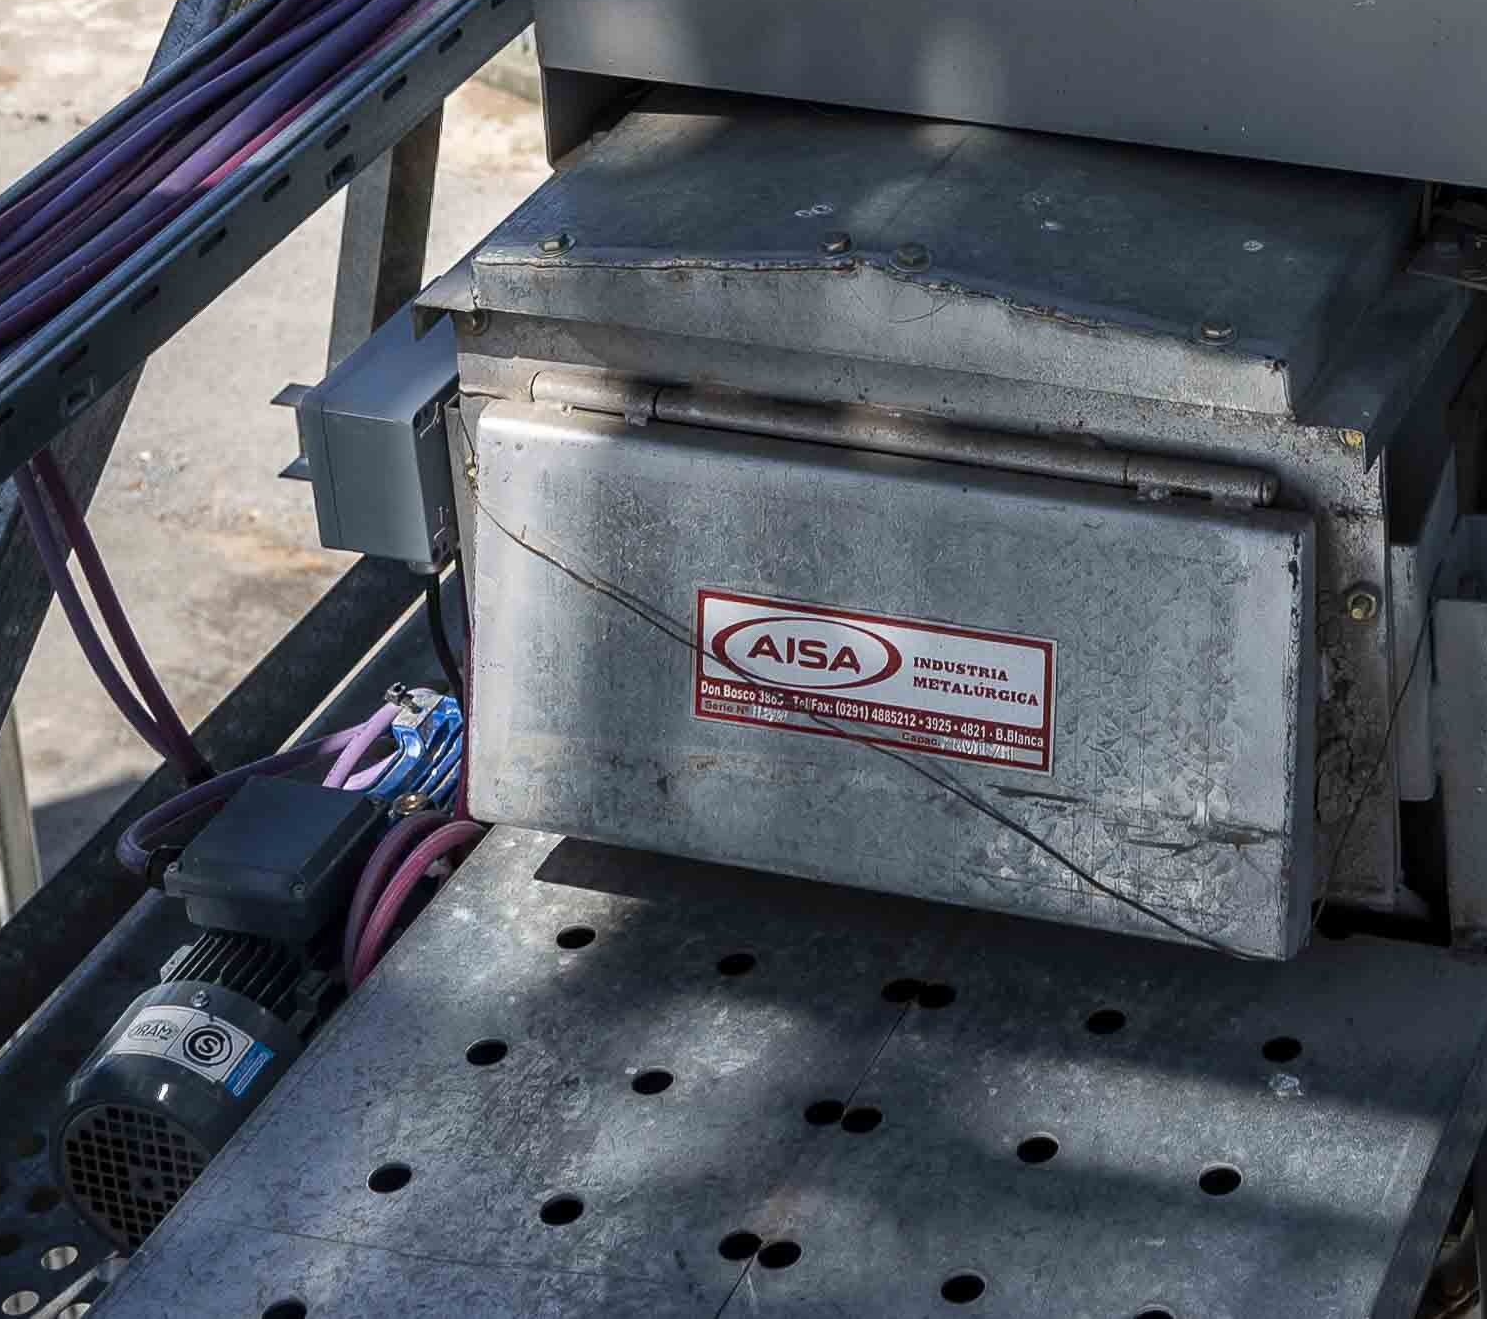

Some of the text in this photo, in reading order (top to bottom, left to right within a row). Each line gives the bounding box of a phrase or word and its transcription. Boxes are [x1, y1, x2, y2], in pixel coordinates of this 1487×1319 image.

[746, 634, 861, 674] AISA
[914, 657, 1009, 682] INDUSTRIA
[913, 676, 1039, 706] METALÚRGICA
[701, 681, 721, 695] Don
[723, 684, 756, 701] Bosco
[835, 701, 868, 721] (0291)
[871, 708, 916, 727] 4885212
[925, 716, 952, 733] 3925
[961, 722, 986, 739] 4821
